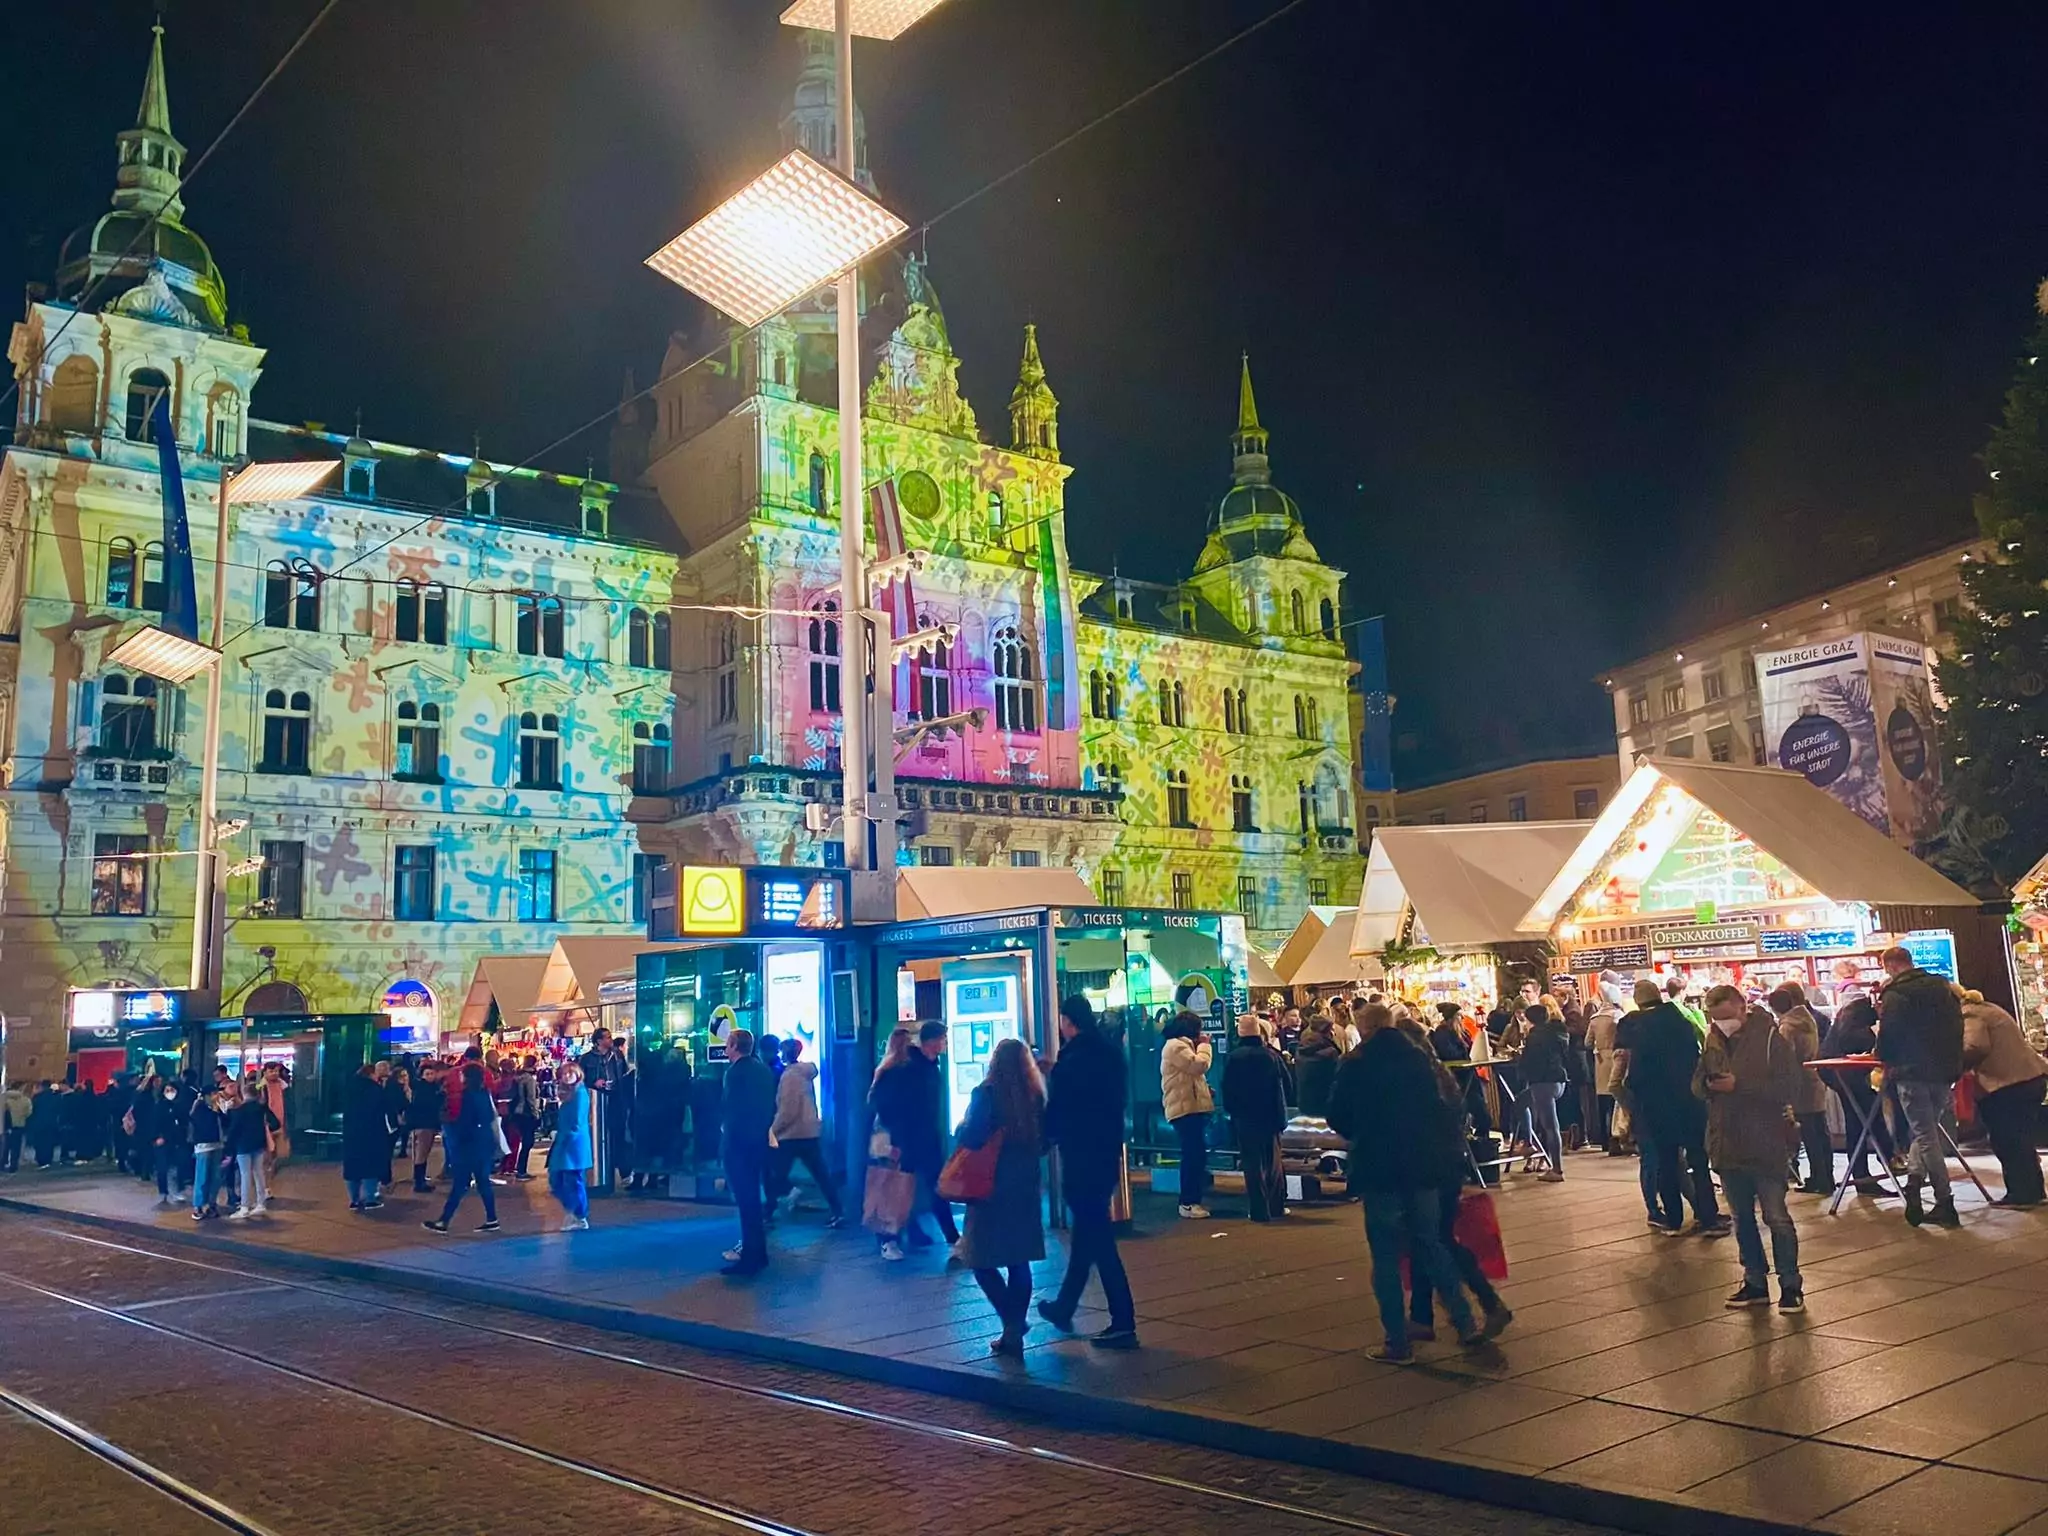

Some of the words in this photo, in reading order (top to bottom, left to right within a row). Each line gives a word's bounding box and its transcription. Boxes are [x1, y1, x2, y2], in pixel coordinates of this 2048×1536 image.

[1773, 648, 1819, 666] ENERGIE
[1823, 640, 1854, 655] GRAZ
[1792, 730, 1830, 751] ENERGIE
[1807, 740, 1841, 760] UNSERE
[1808, 757, 1832, 773] STADT
[998, 914, 1036, 929] TICKETS
[1083, 913, 1123, 925] TICKETS
[1162, 915, 1199, 928] TICKETS
[882, 929, 914, 942] TICKETS
[939, 922, 974, 935] TICKETS
[1655, 927, 1751, 944] OFENKARTOFFEL
[964, 985, 998, 1000] GRAZ
